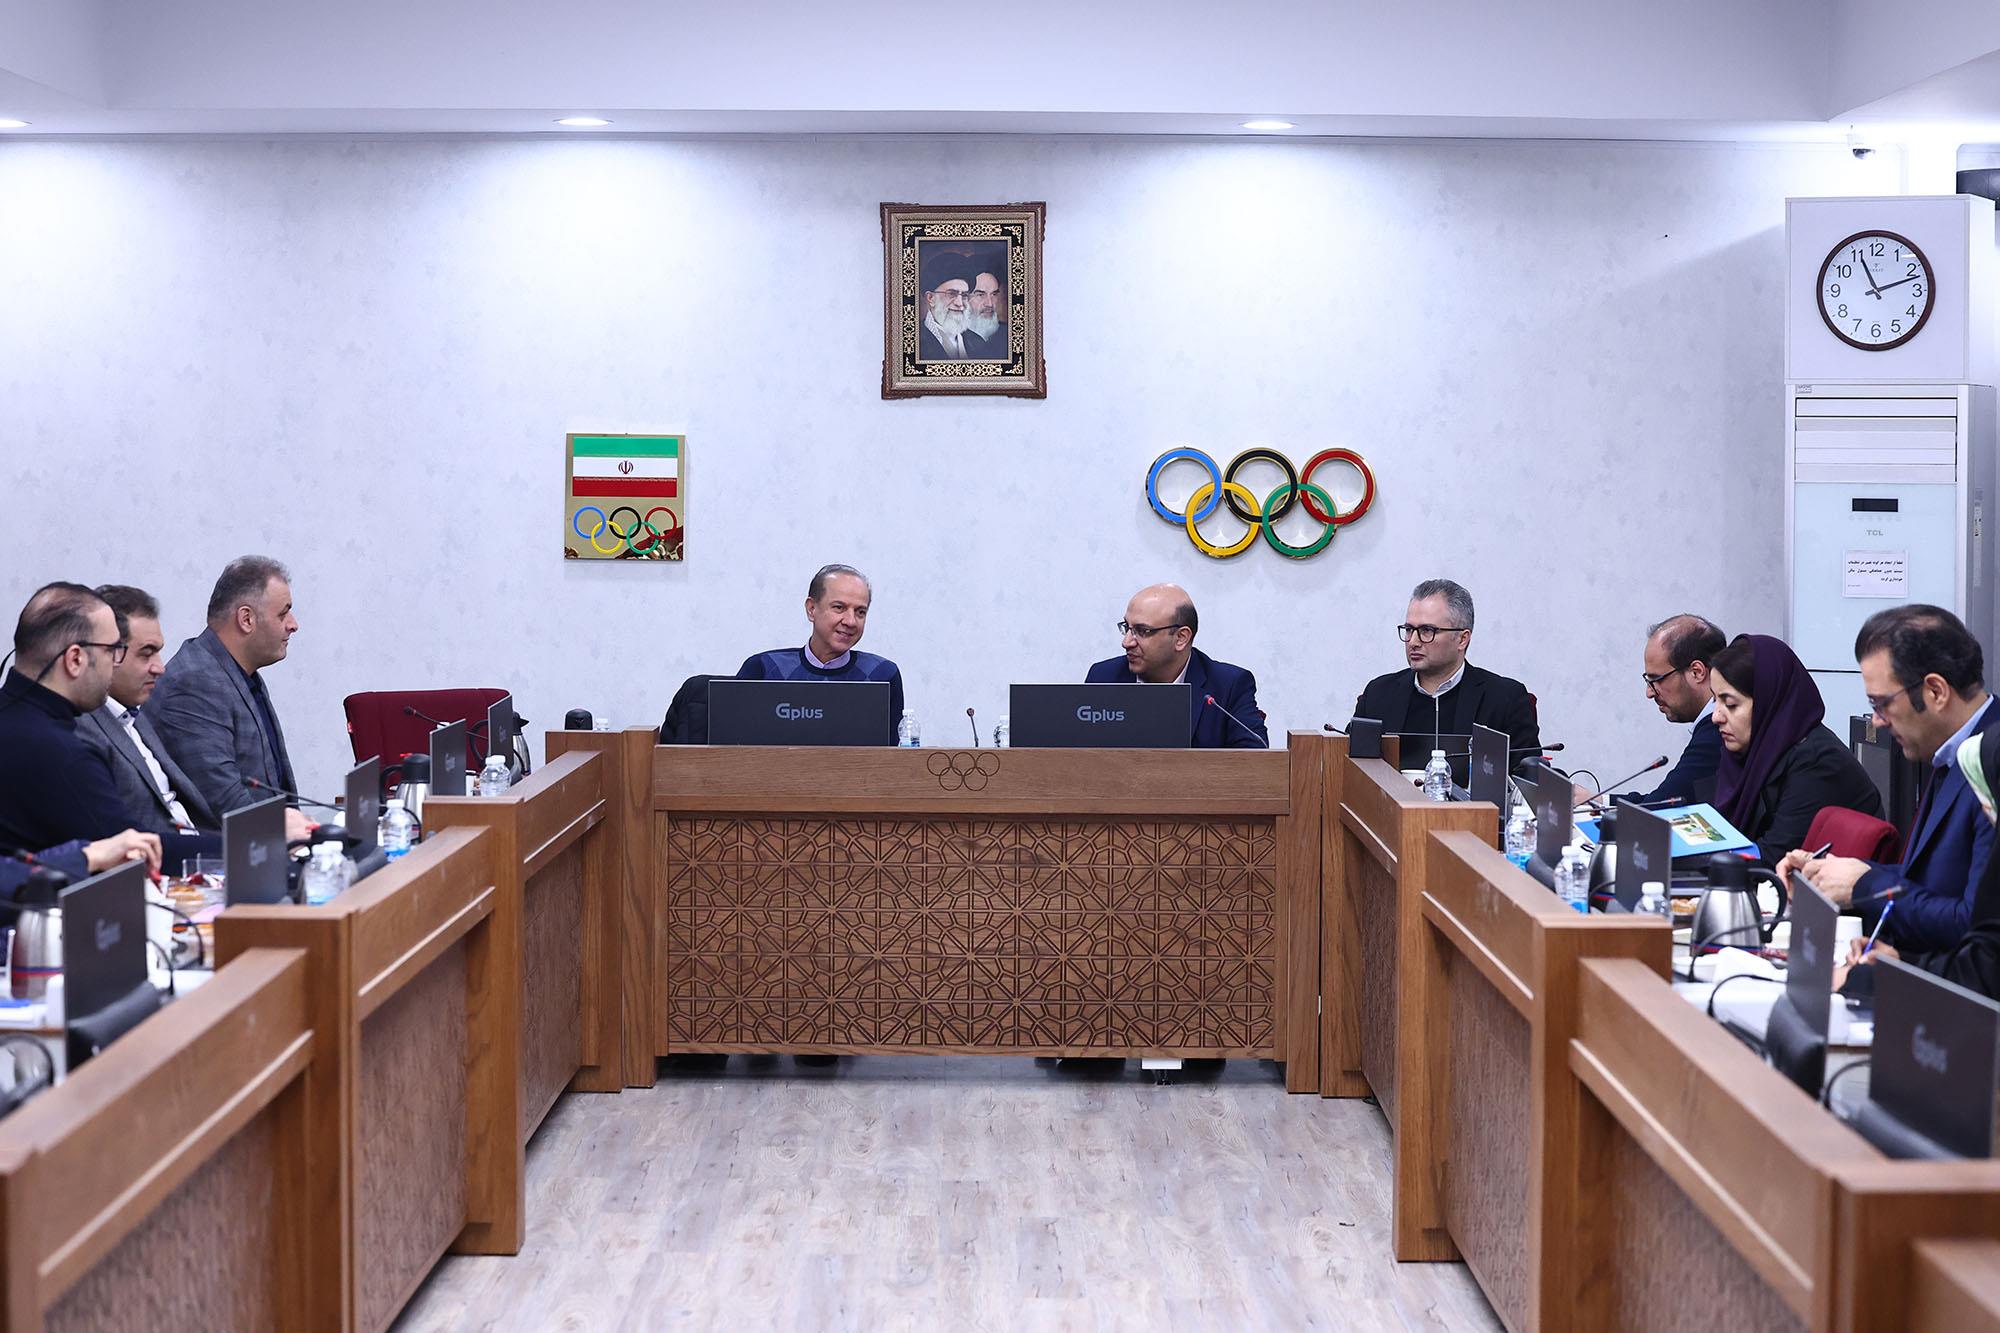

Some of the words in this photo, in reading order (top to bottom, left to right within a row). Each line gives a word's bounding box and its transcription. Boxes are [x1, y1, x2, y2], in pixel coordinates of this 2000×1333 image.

[1869, 243, 1885, 257] 12
[1894, 249, 1900, 262] 1
[1836, 265, 1852, 278] 10
[1906, 263, 1917, 277] 2
[1830, 284, 1841, 298] 9
[1912, 284, 1923, 298] 3
[1837, 304, 1848, 318] 8
[1906, 304, 1916, 318] 4
[1852, 319, 1863, 333] 7
[1871, 324, 1882, 338] 6
[1890, 320, 1901, 333] 5
[775, 702, 824, 721] Gplus
[1076, 705, 1125, 723] Gplus
